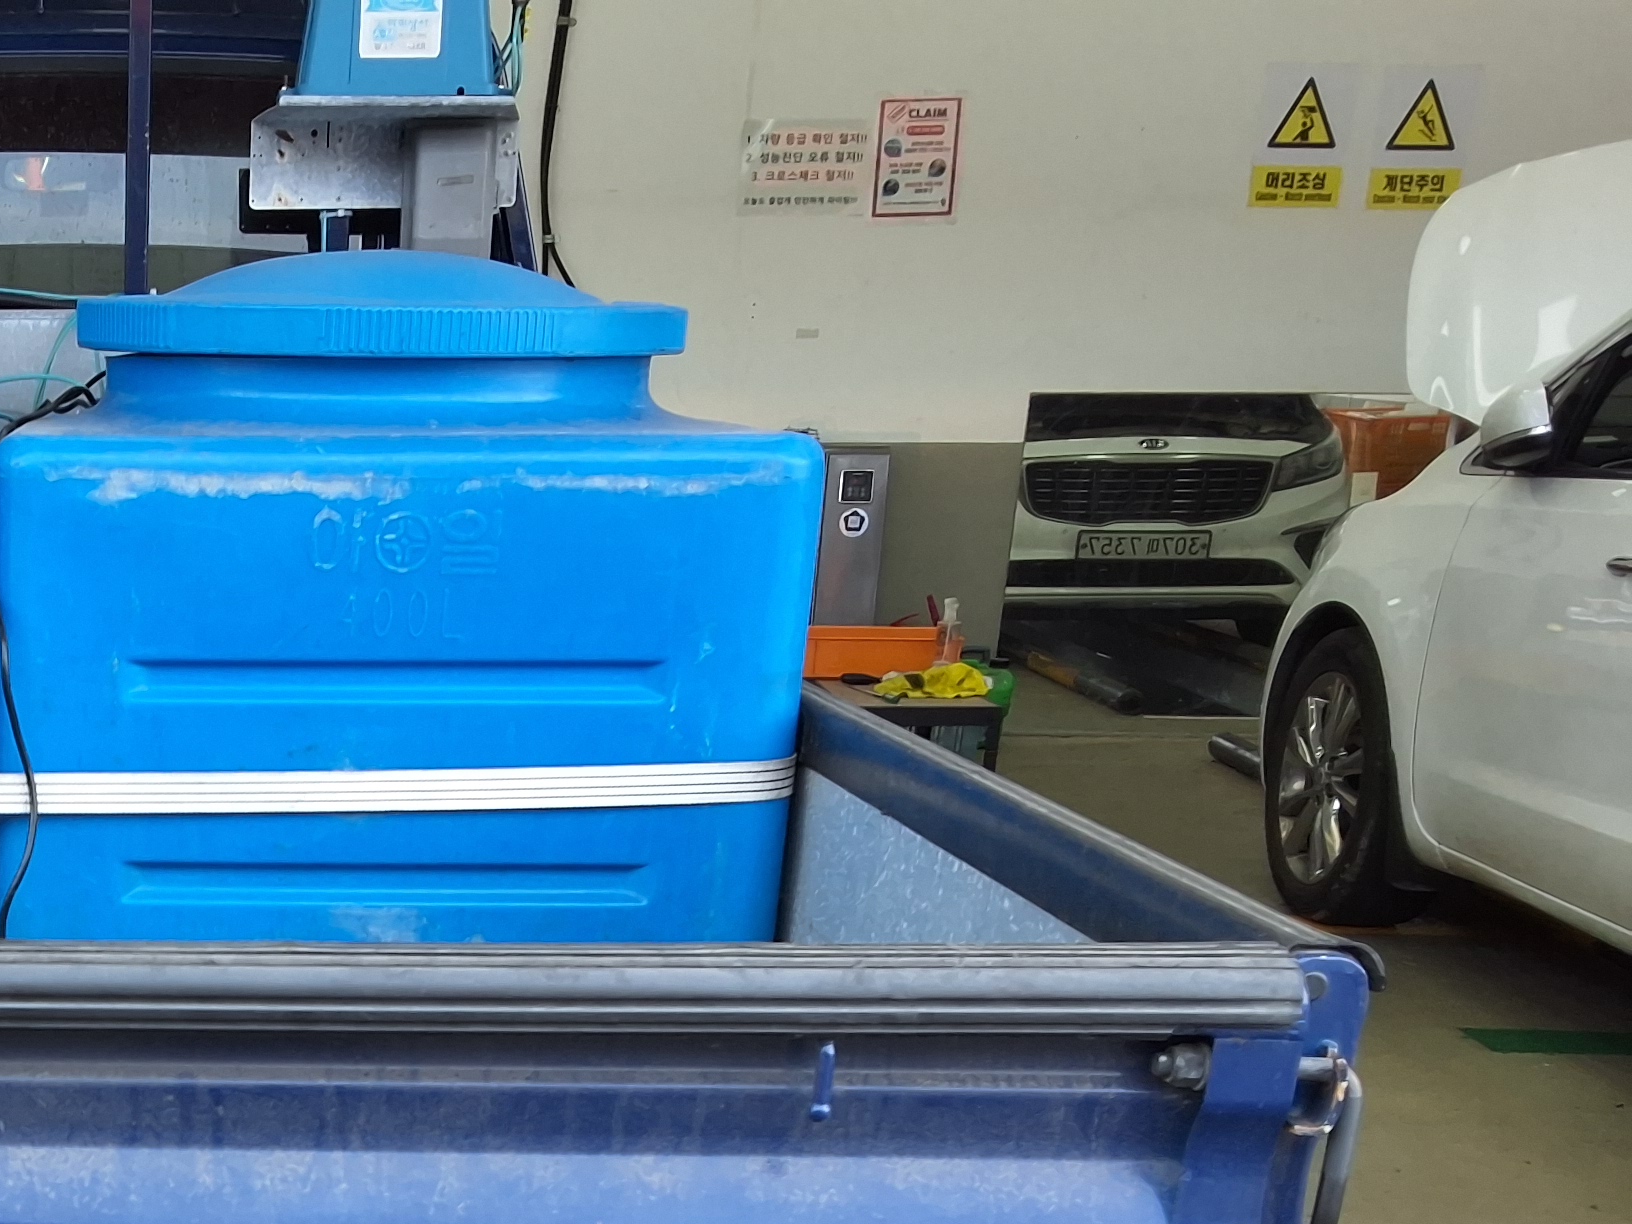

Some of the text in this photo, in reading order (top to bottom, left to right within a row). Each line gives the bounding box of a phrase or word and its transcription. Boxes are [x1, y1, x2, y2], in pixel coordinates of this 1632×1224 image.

[908, 107, 948, 118] CLAIM
[1265, 171, 1327, 190] 머리조심
[1382, 173, 1445, 193] 계단주의
